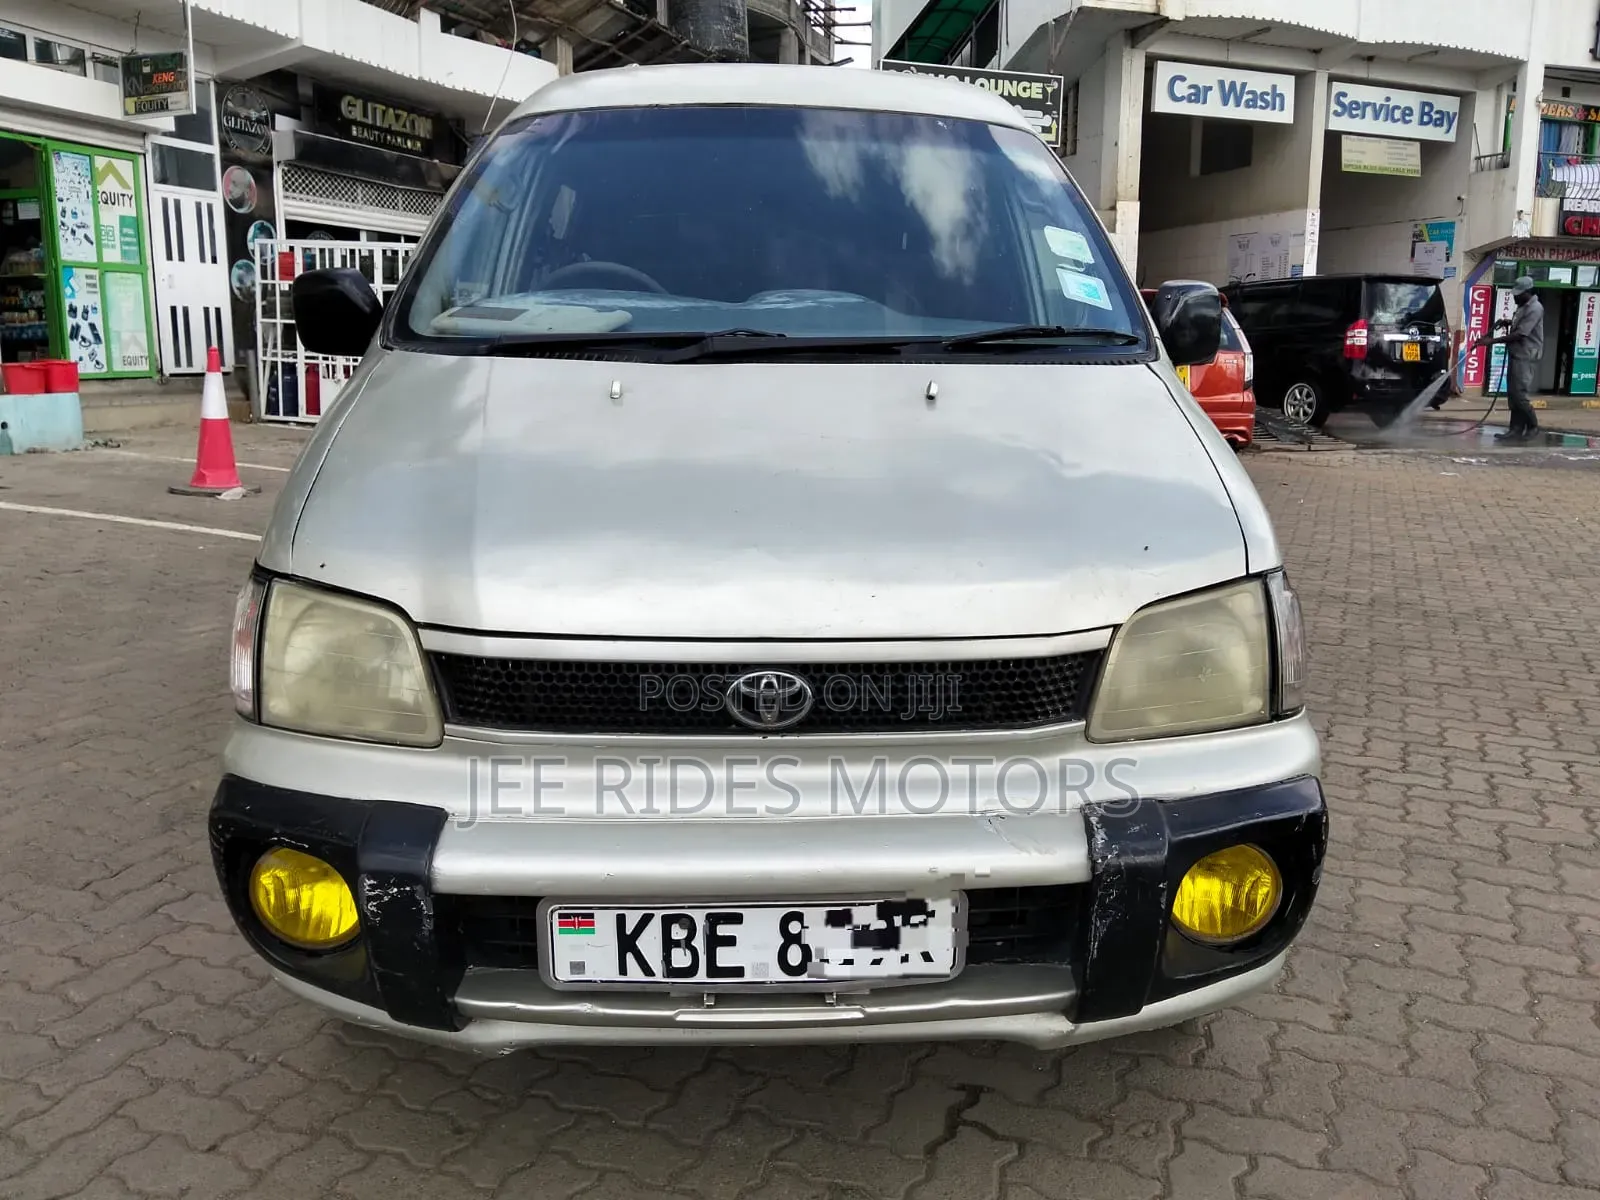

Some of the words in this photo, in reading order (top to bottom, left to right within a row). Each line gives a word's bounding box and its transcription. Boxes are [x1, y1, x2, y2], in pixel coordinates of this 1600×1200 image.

[1167, 75, 1213, 106] Car
[1217, 79, 1286, 112] Wash
[1332, 91, 1413, 125] Service
[1418, 101, 1457, 134] Bay
[341, 95, 433, 139] GLITAZON
[351, 125, 385, 143] BEAUTY
[1565, 215, 1600, 237] CH
[1549, 248, 1600, 264] PHARMA
[1467, 289, 1486, 382] CHEMIST
[1584, 296, 1596, 345] CHEMIST
[122, 355, 149, 367] EQUITY
[615, 912, 745, 979] KBE
